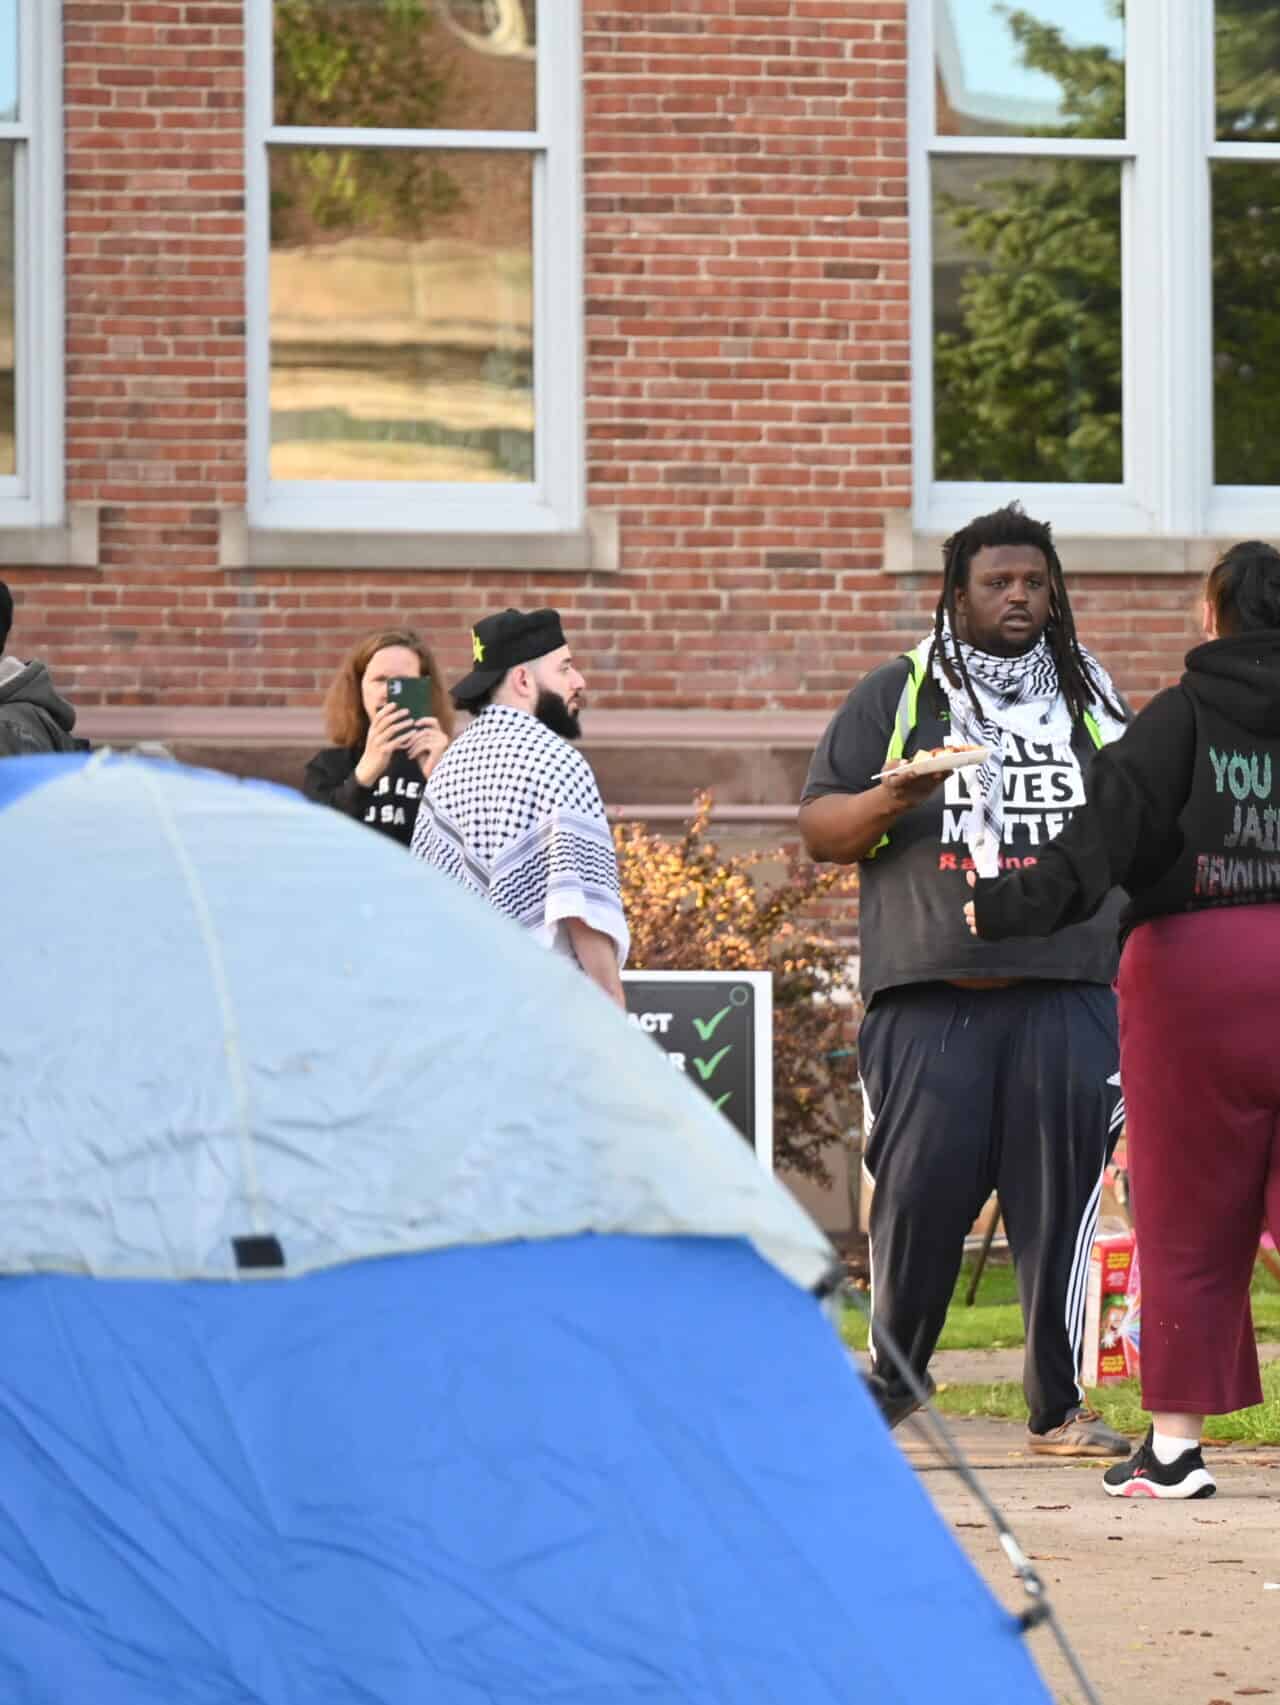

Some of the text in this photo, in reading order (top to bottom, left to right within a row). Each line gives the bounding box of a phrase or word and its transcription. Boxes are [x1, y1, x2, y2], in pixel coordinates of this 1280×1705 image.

[958, 771, 1074, 803] LVES
[1209, 746, 1272, 800] YOU
[938, 853, 1038, 871] Raine
